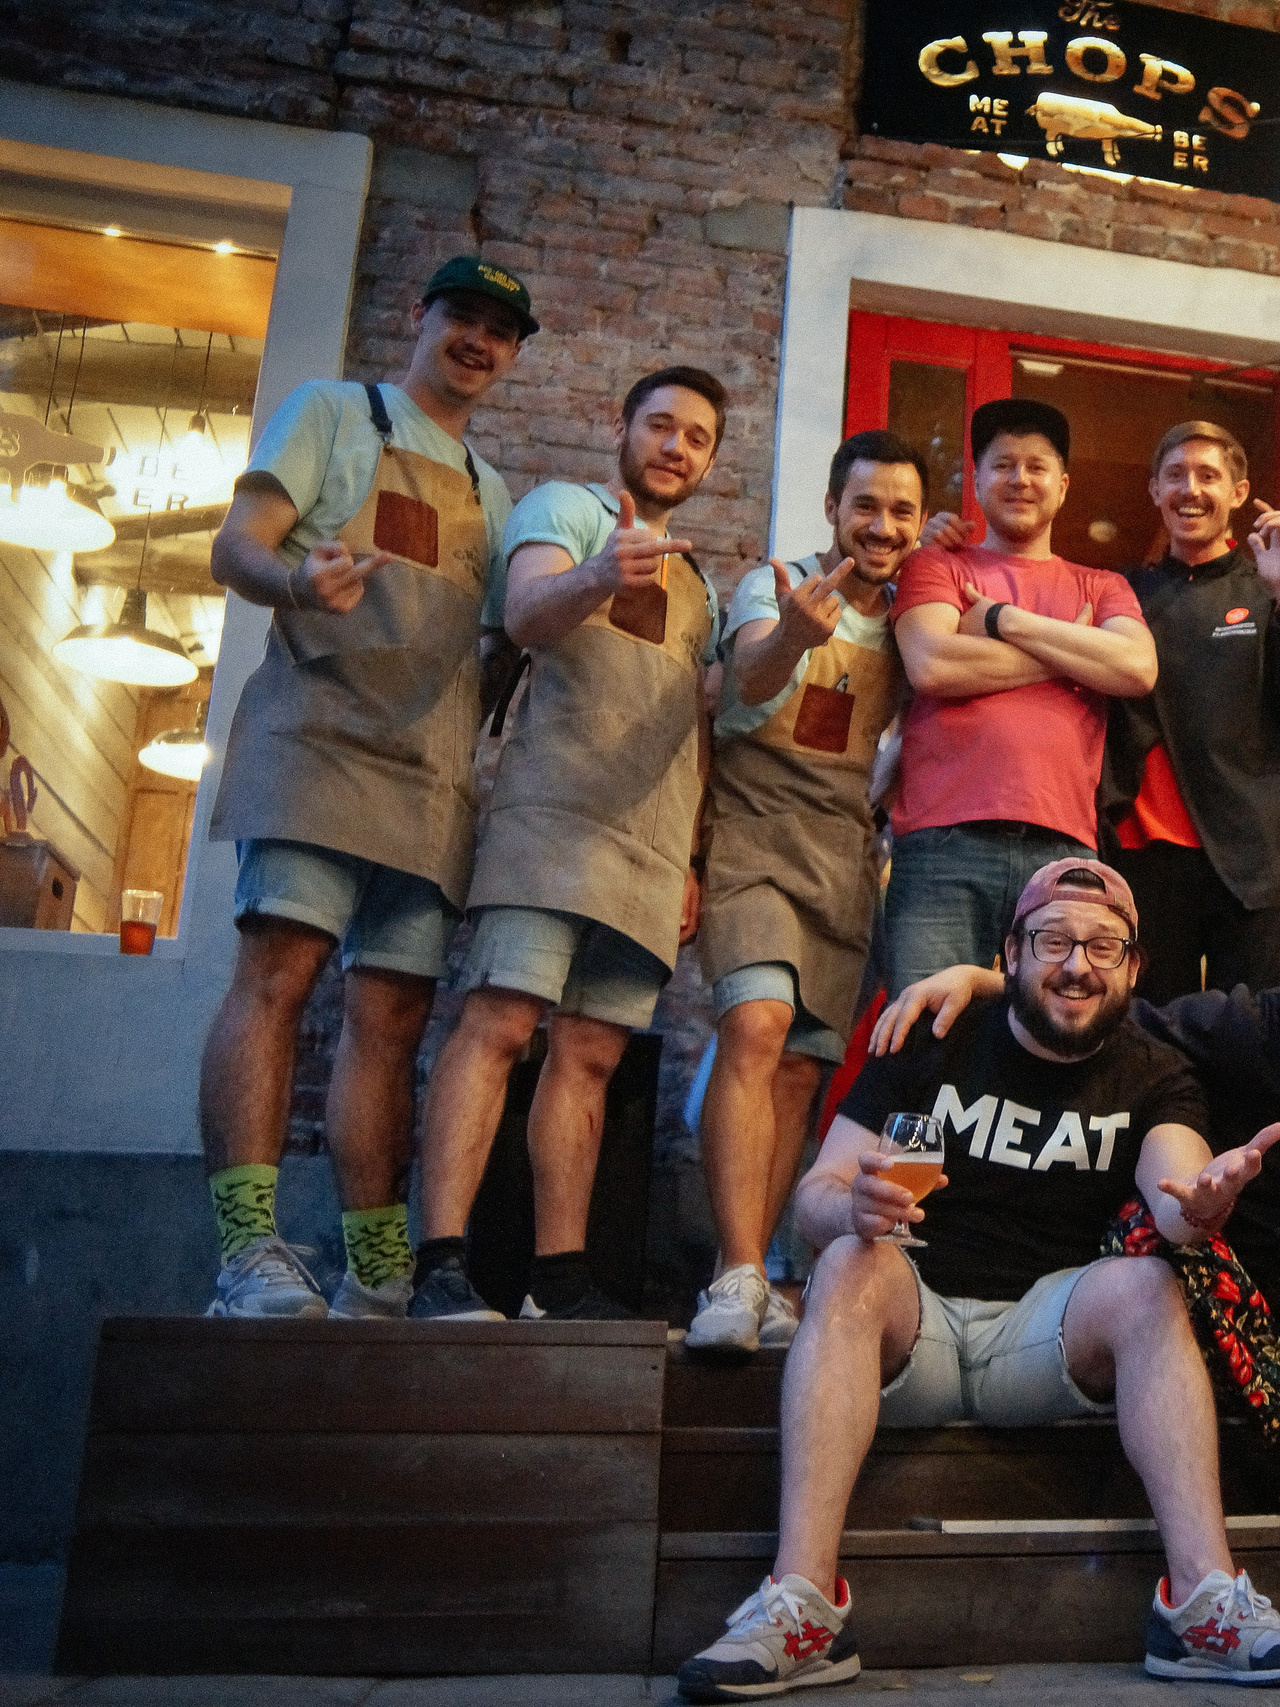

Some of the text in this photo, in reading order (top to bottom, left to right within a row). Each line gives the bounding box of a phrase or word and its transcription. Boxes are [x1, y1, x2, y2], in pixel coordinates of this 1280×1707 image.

[1058, 0, 1120, 31] The
[918, 31, 1261, 140] CHOPS
[969, 94, 1009, 116] ME
[970, 116, 1007, 135] AT
[1173, 131, 1206, 150] BE
[1173, 152, 1209, 172] ER
[927, 1084, 1130, 1172] MEAT
